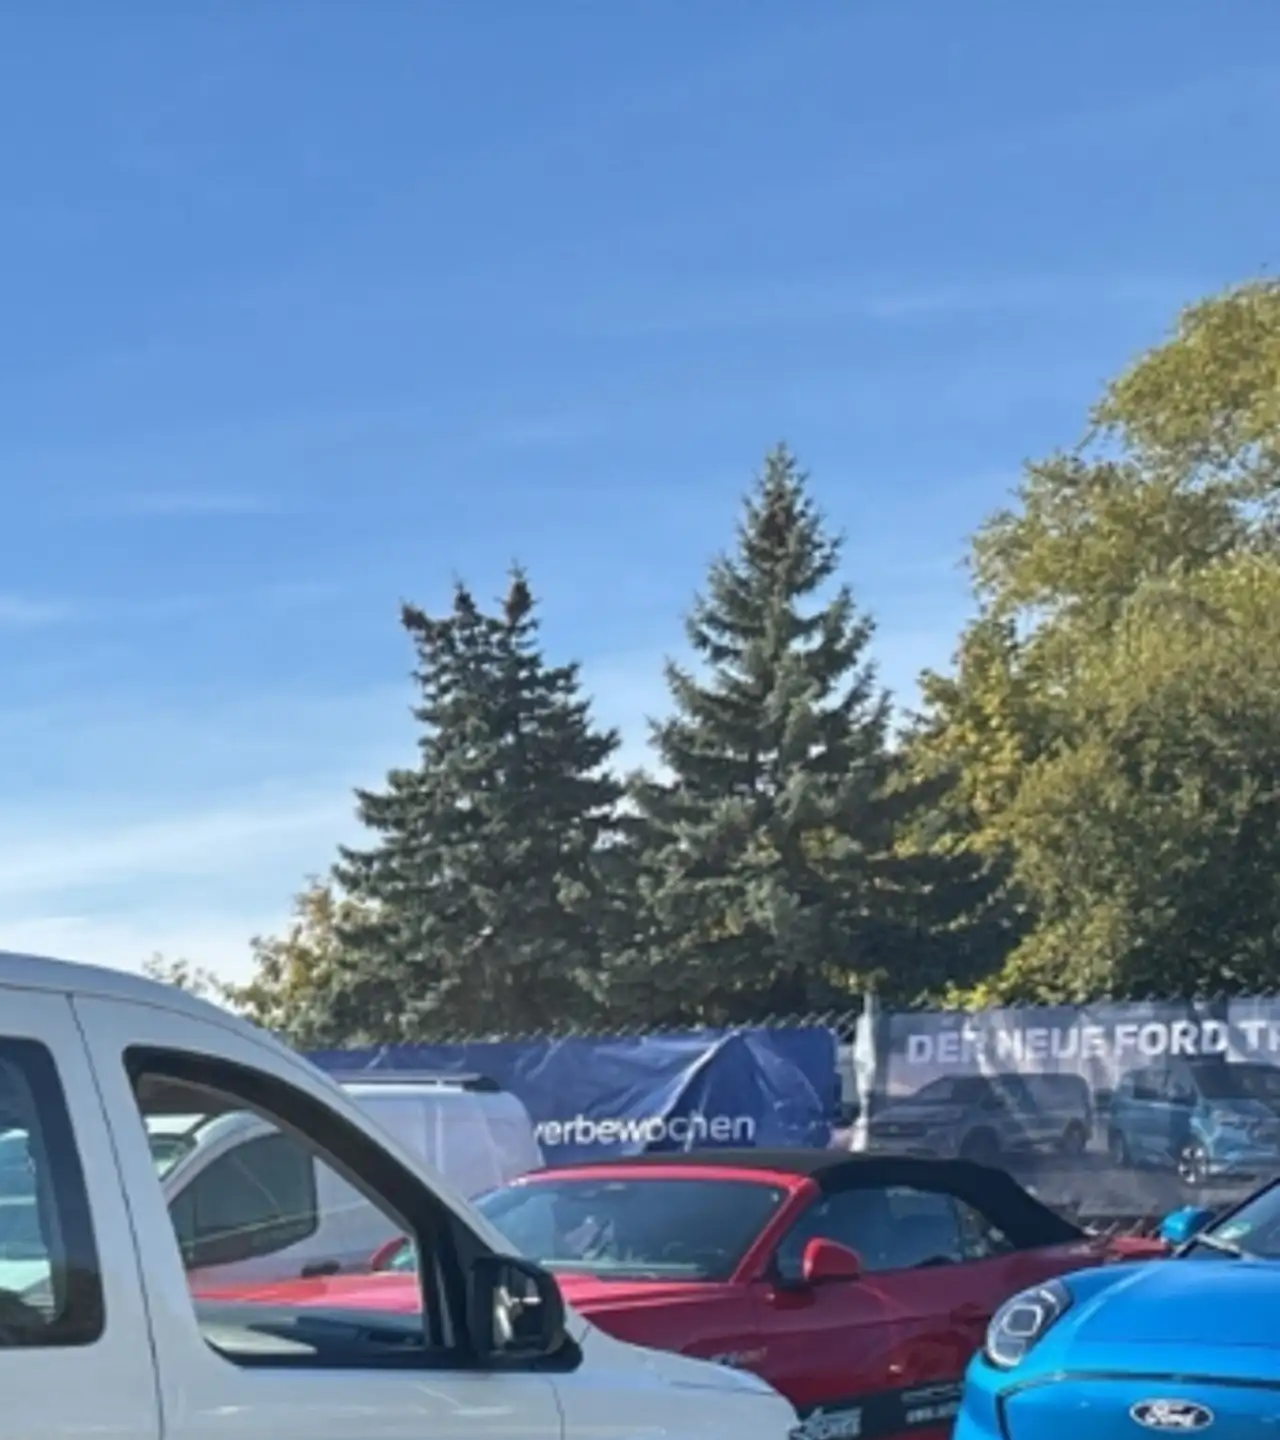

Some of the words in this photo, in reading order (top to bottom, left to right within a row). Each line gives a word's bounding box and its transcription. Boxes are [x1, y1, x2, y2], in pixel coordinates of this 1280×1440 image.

[906, 1028, 987, 1064] DER
[996, 1024, 1105, 1061] NEUE
[1114, 1020, 1229, 1057] FORD
